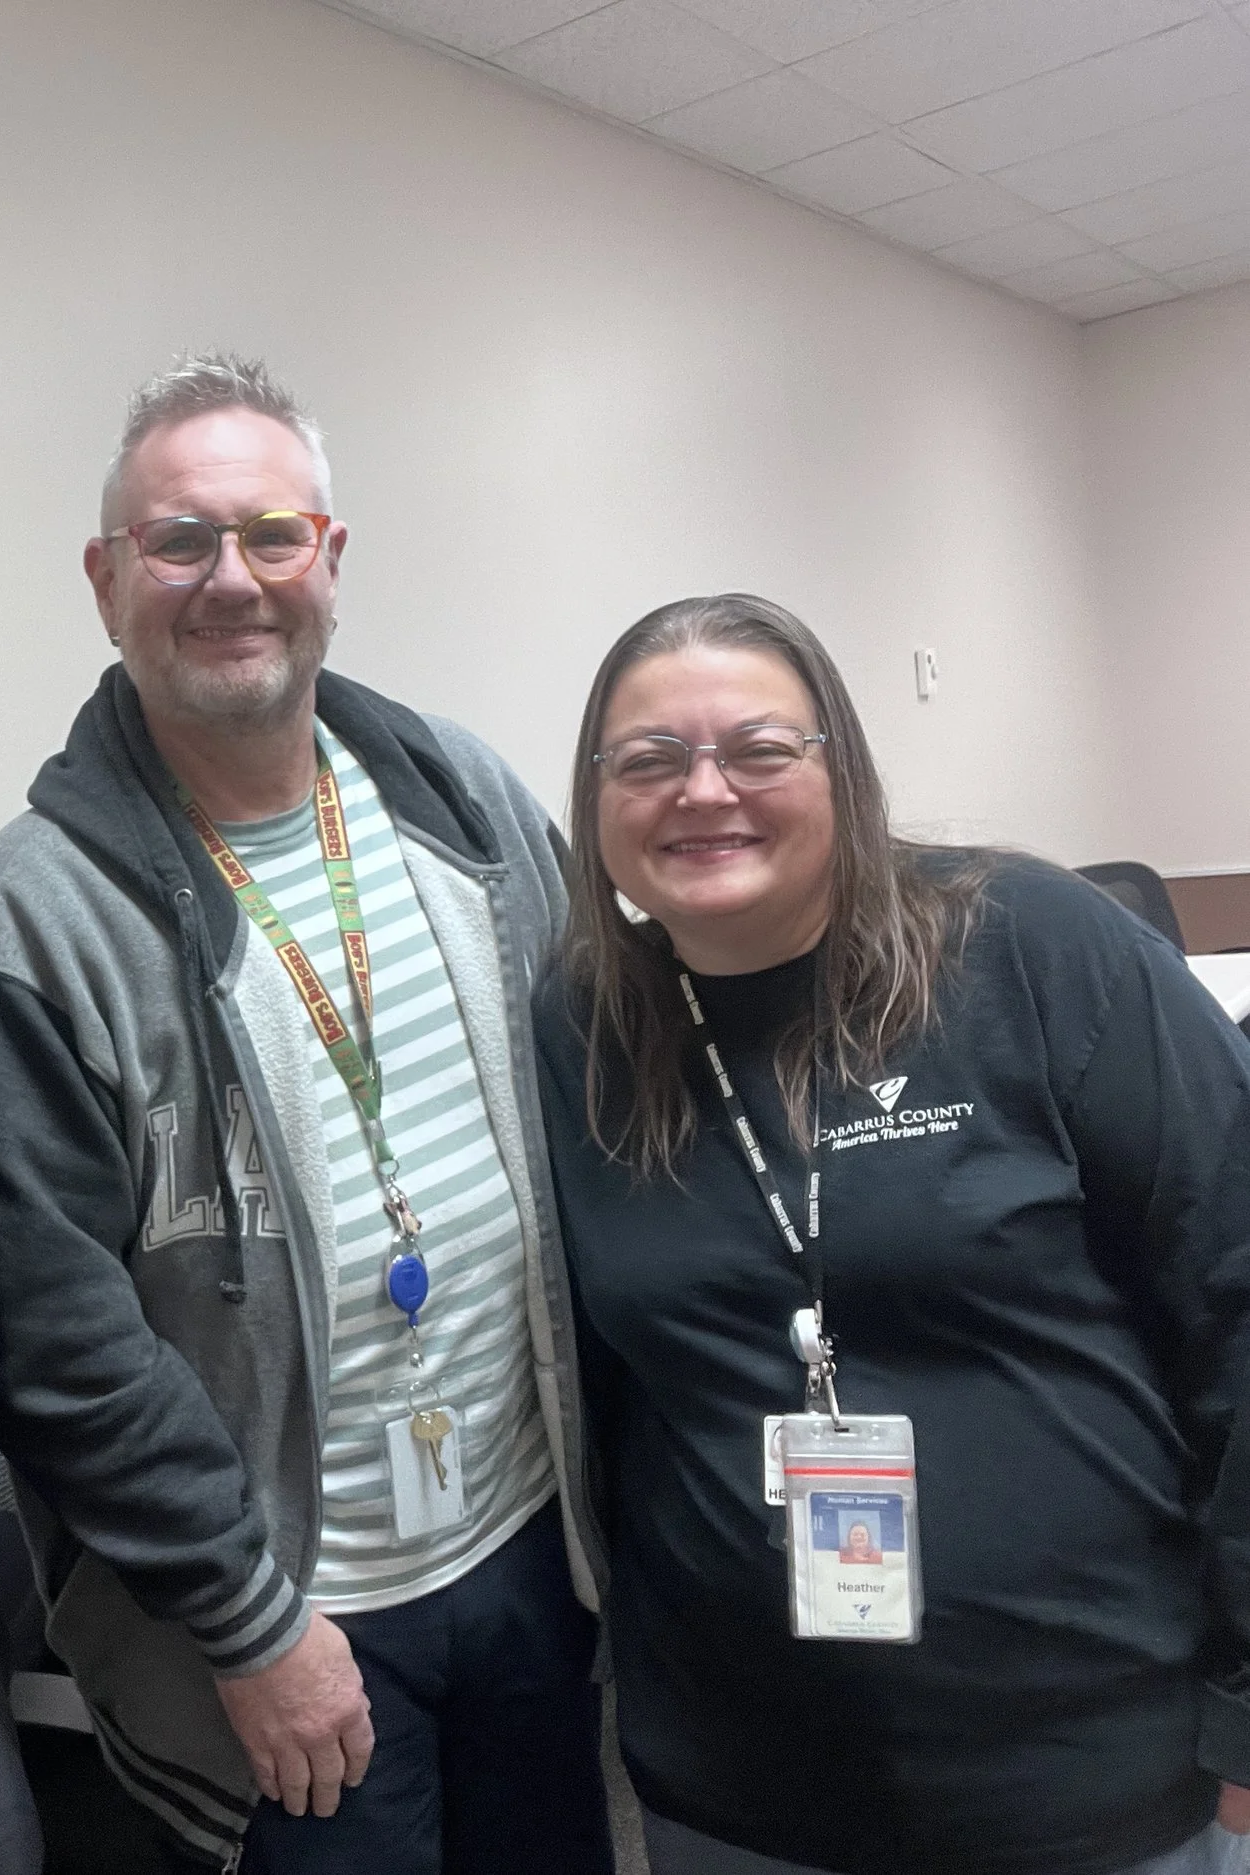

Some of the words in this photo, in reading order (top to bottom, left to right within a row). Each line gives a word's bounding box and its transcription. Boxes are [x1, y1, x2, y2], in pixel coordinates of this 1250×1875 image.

[320, 804, 343, 857] BURGERS
[217, 852, 248, 886] BOB'S
[284, 945, 325, 1004] BURGERS
[314, 1001, 344, 1041] BOB'S
[899, 1103, 974, 1124] COUNTY
[832, 1132, 878, 1151] America
[880, 1126, 925, 1141] Thrives
[927, 1119, 959, 1134] Here
[837, 1581, 885, 1593] Heather
